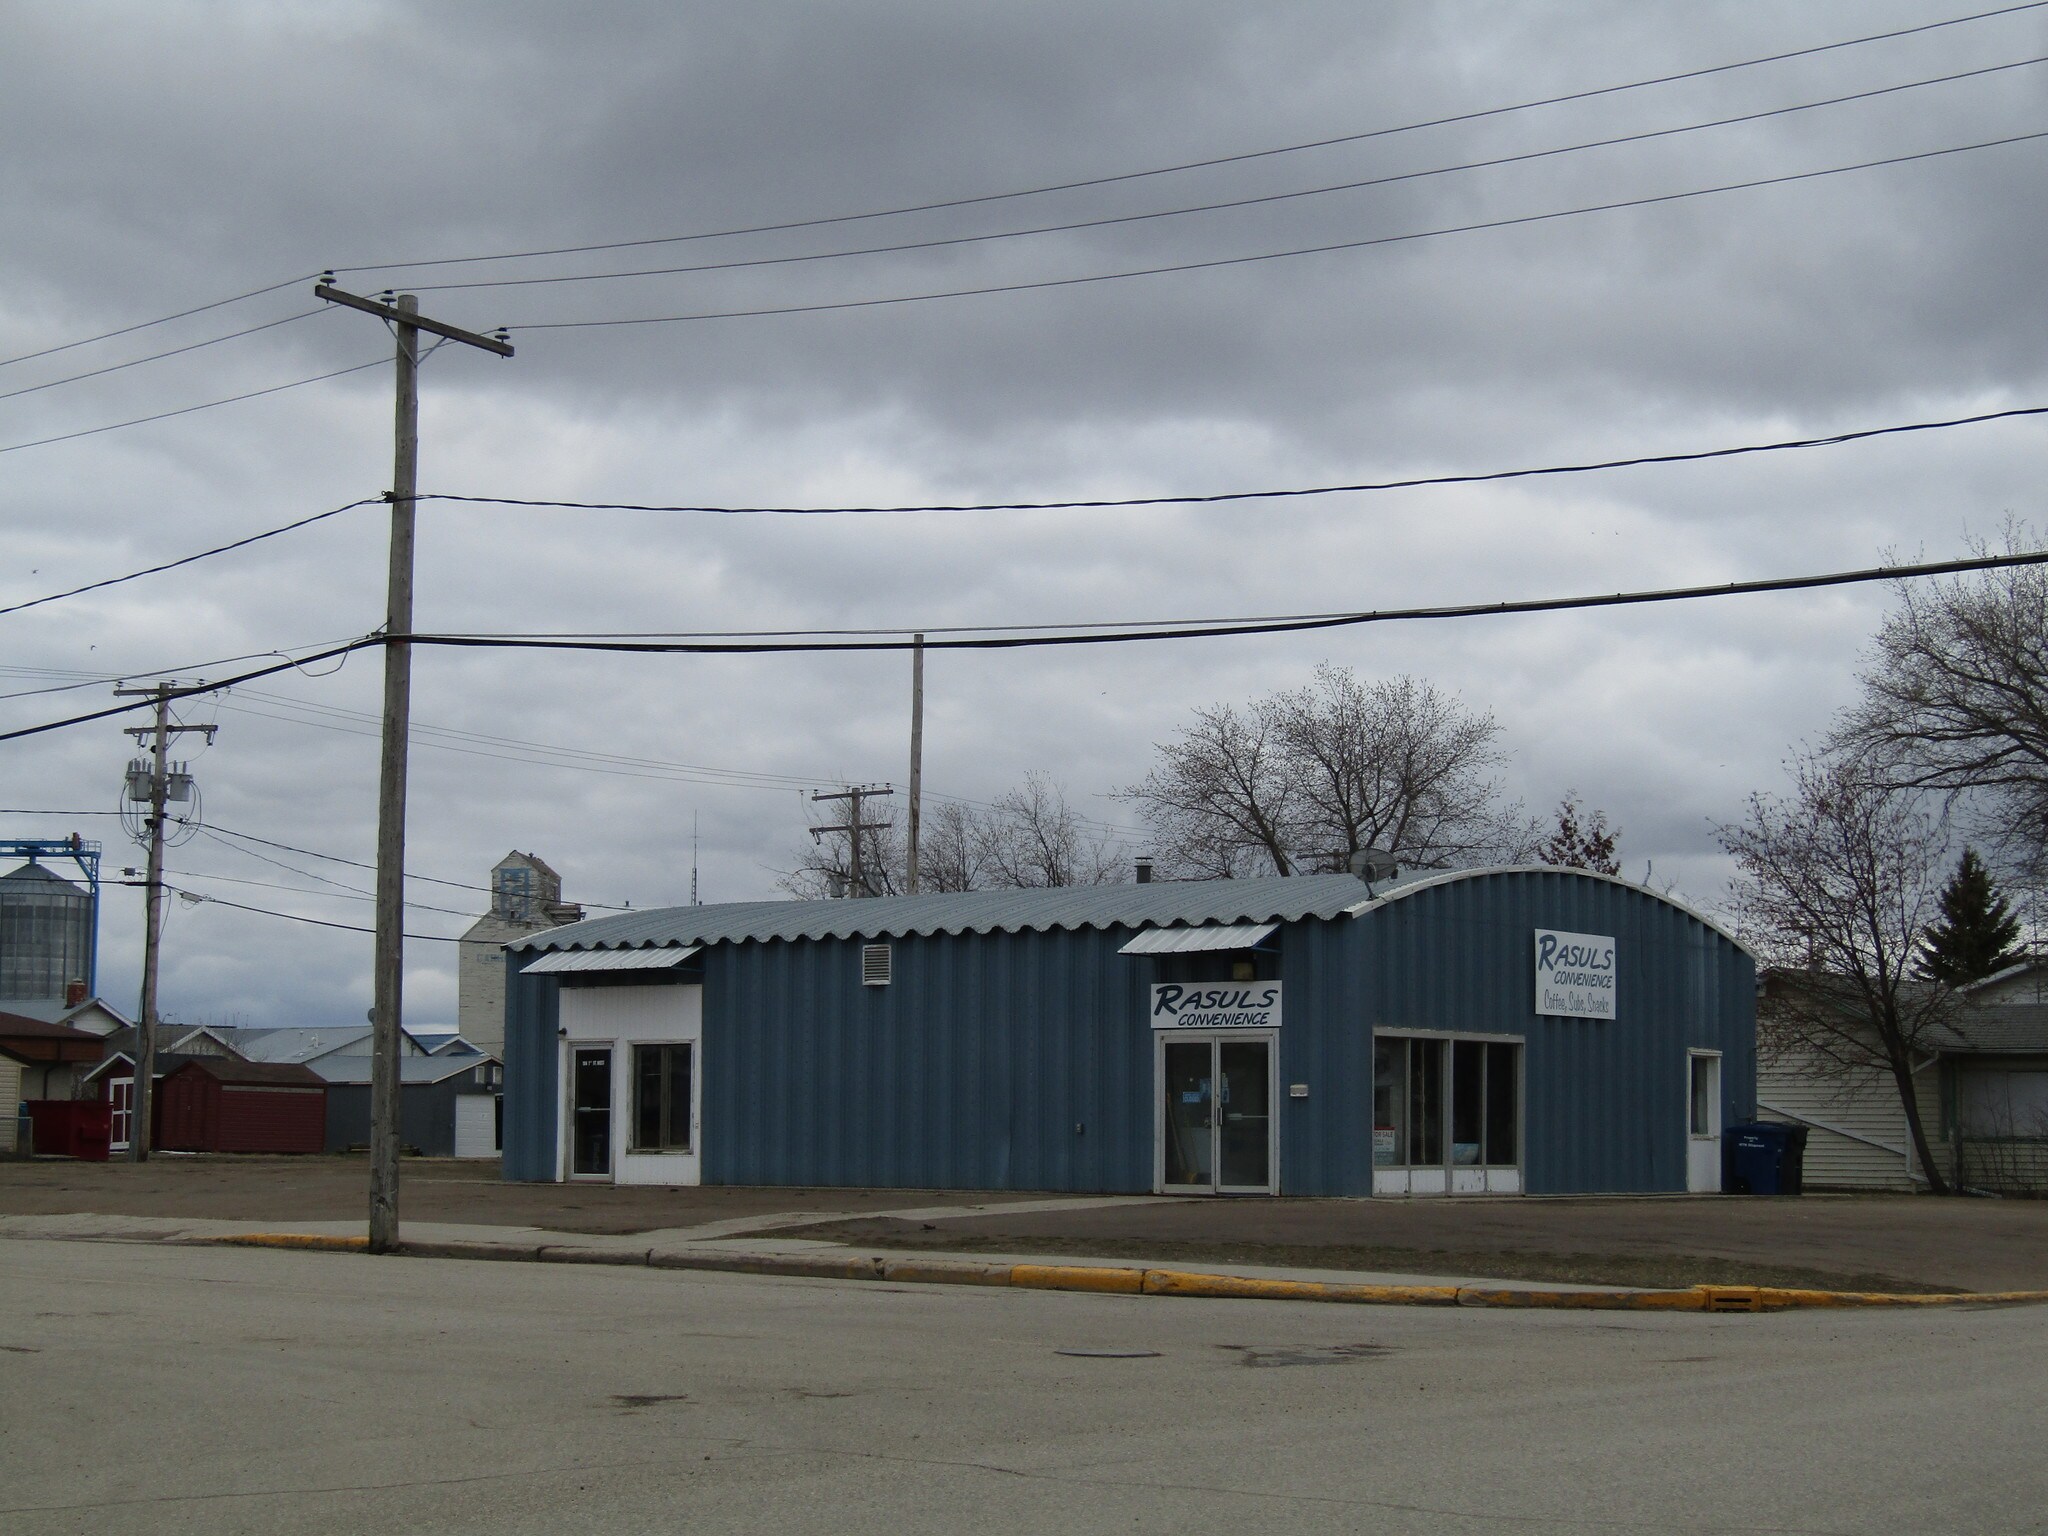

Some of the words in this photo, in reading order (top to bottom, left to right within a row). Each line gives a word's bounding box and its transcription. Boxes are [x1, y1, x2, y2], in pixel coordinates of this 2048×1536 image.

[1538, 934, 1614, 972] RASULS
[1554, 971, 1613, 989] CONVENIENCE
[1154, 985, 1279, 1016] RASULS
[1544, 989, 1567, 1014] Coffee,
[1569, 991, 1586, 1014] Subs,
[1587, 992, 1609, 1013] Snacks
[1178, 1012, 1270, 1026] CONVENIENCE
